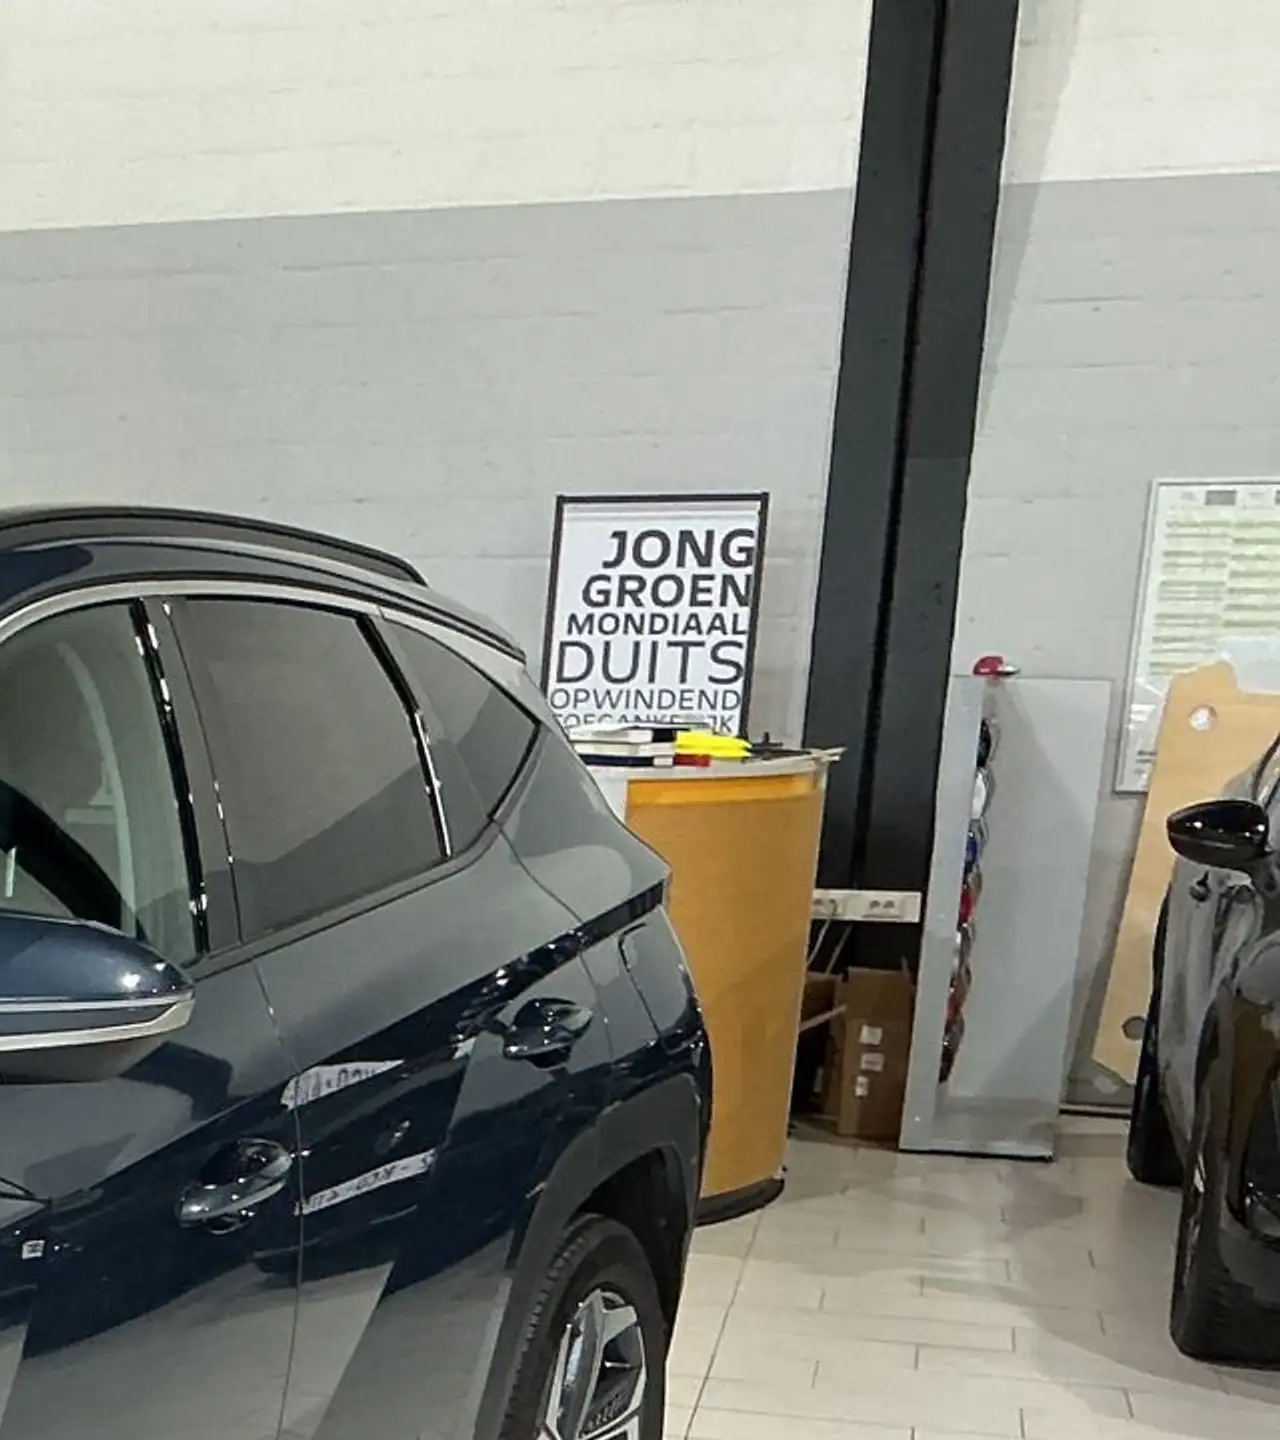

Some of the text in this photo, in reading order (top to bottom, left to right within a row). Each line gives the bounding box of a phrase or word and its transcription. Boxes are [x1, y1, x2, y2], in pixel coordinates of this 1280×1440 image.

[603, 530, 755, 568] JONG
[583, 574, 751, 607] GROEN
[567, 613, 748, 635] MONDIAAL
[557, 641, 744, 684] DUITS
[551, 689, 741, 710] OPWINDEND
